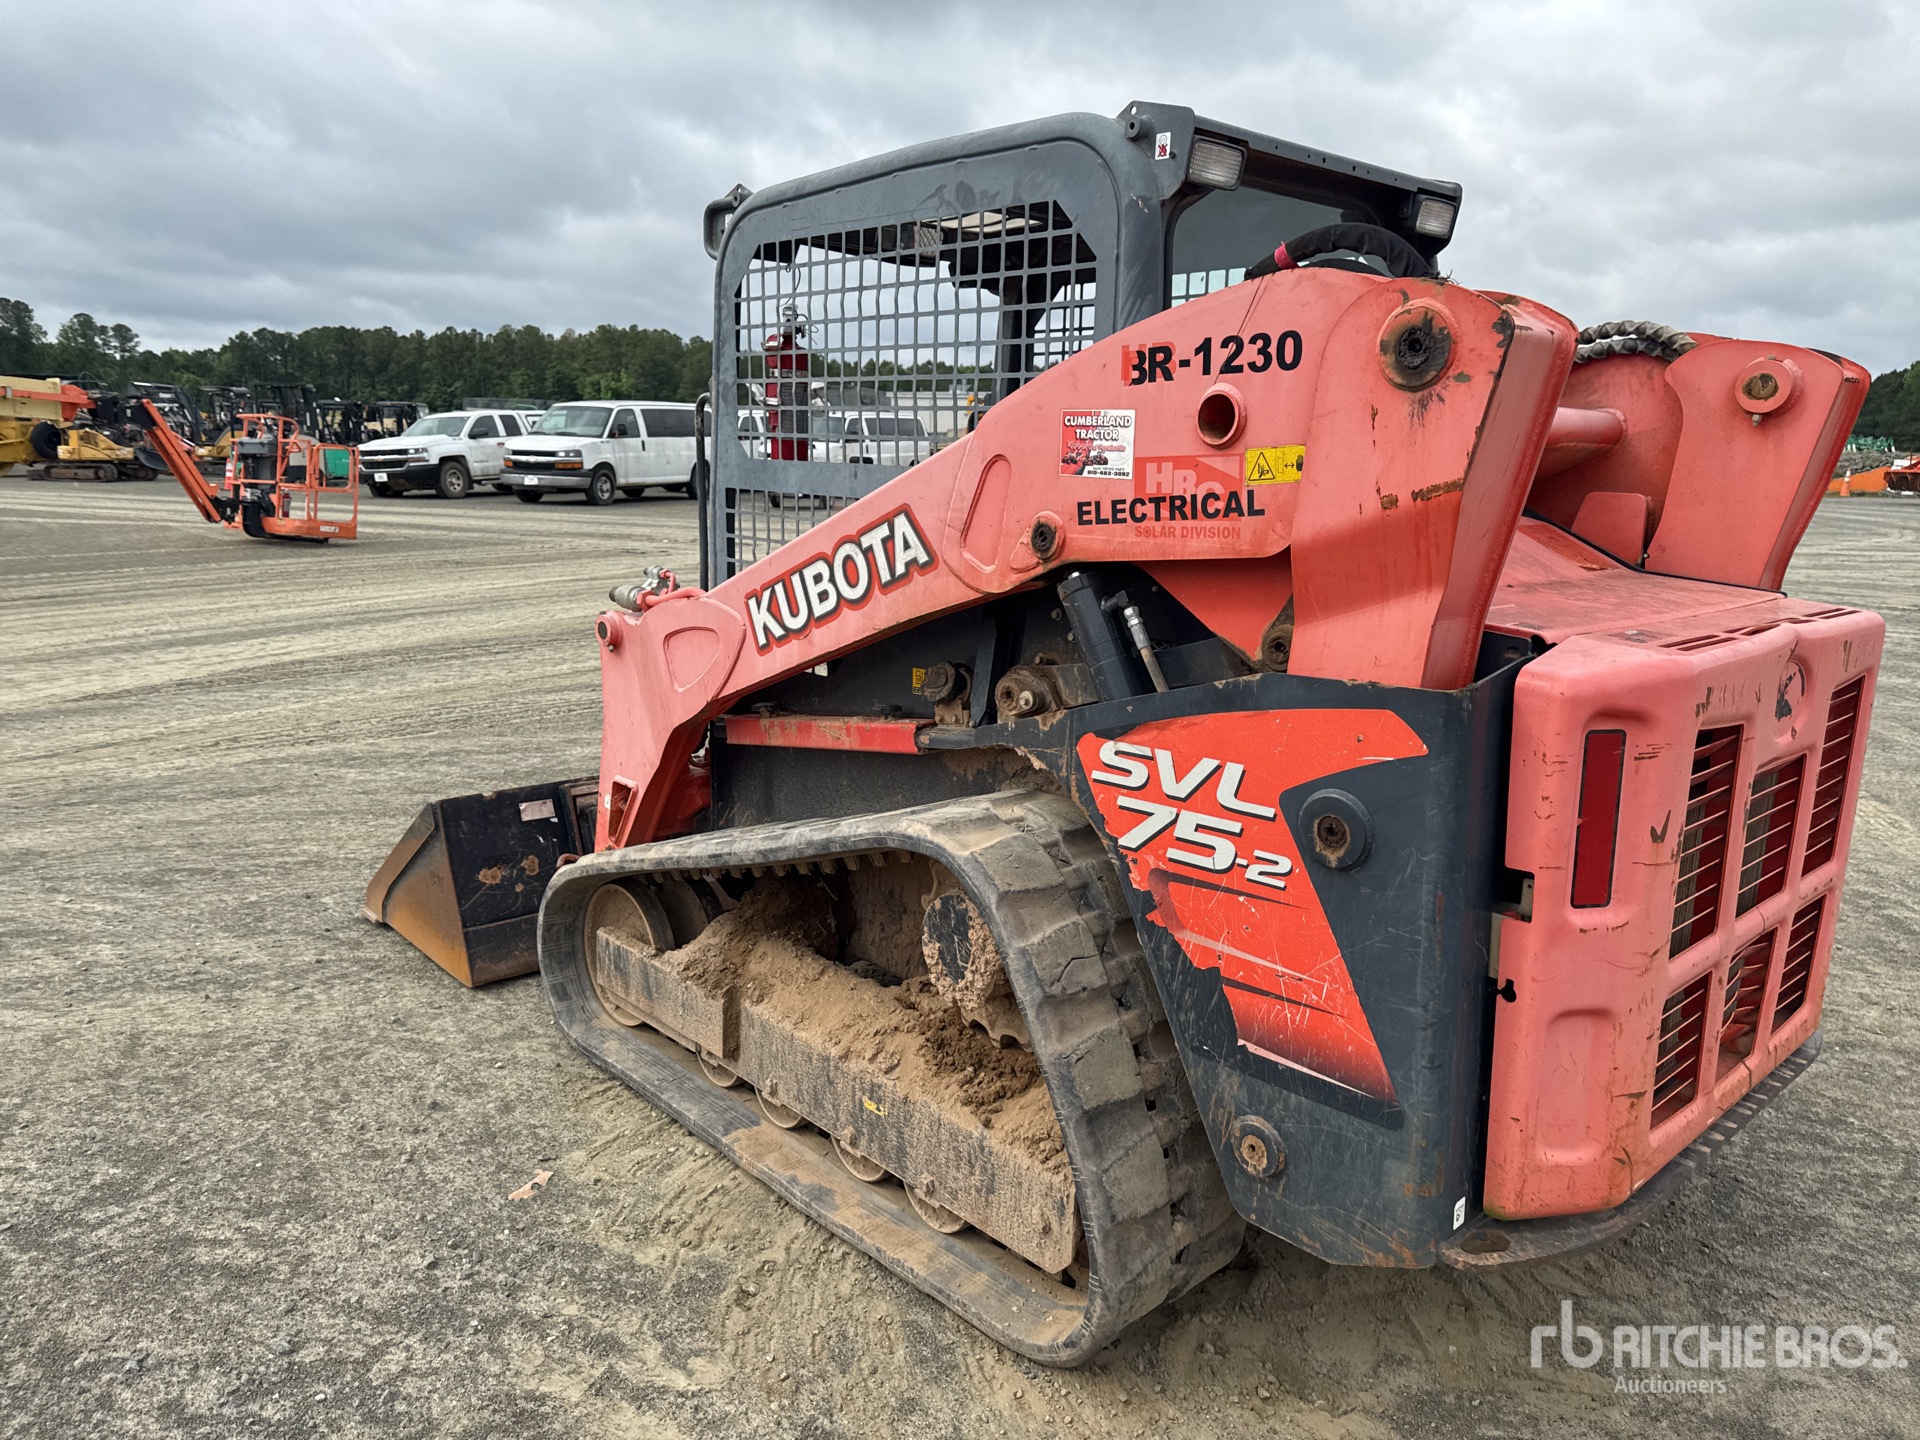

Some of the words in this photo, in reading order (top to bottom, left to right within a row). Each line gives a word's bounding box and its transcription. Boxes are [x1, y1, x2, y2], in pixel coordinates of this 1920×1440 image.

[1064, 415, 1132, 427] CUMBERLAND
[1075, 428, 1119, 440] TRACTOR
[1077, 489, 1266, 526] ELECTRICAL
[1134, 525, 1177, 538] SOLAR
[1180, 526, 1241, 539] DIVISION
[746, 511, 933, 649] KUBOTA
[1091, 741, 1277, 821] SVL
[1116, 796, 1293, 891] 75-2
